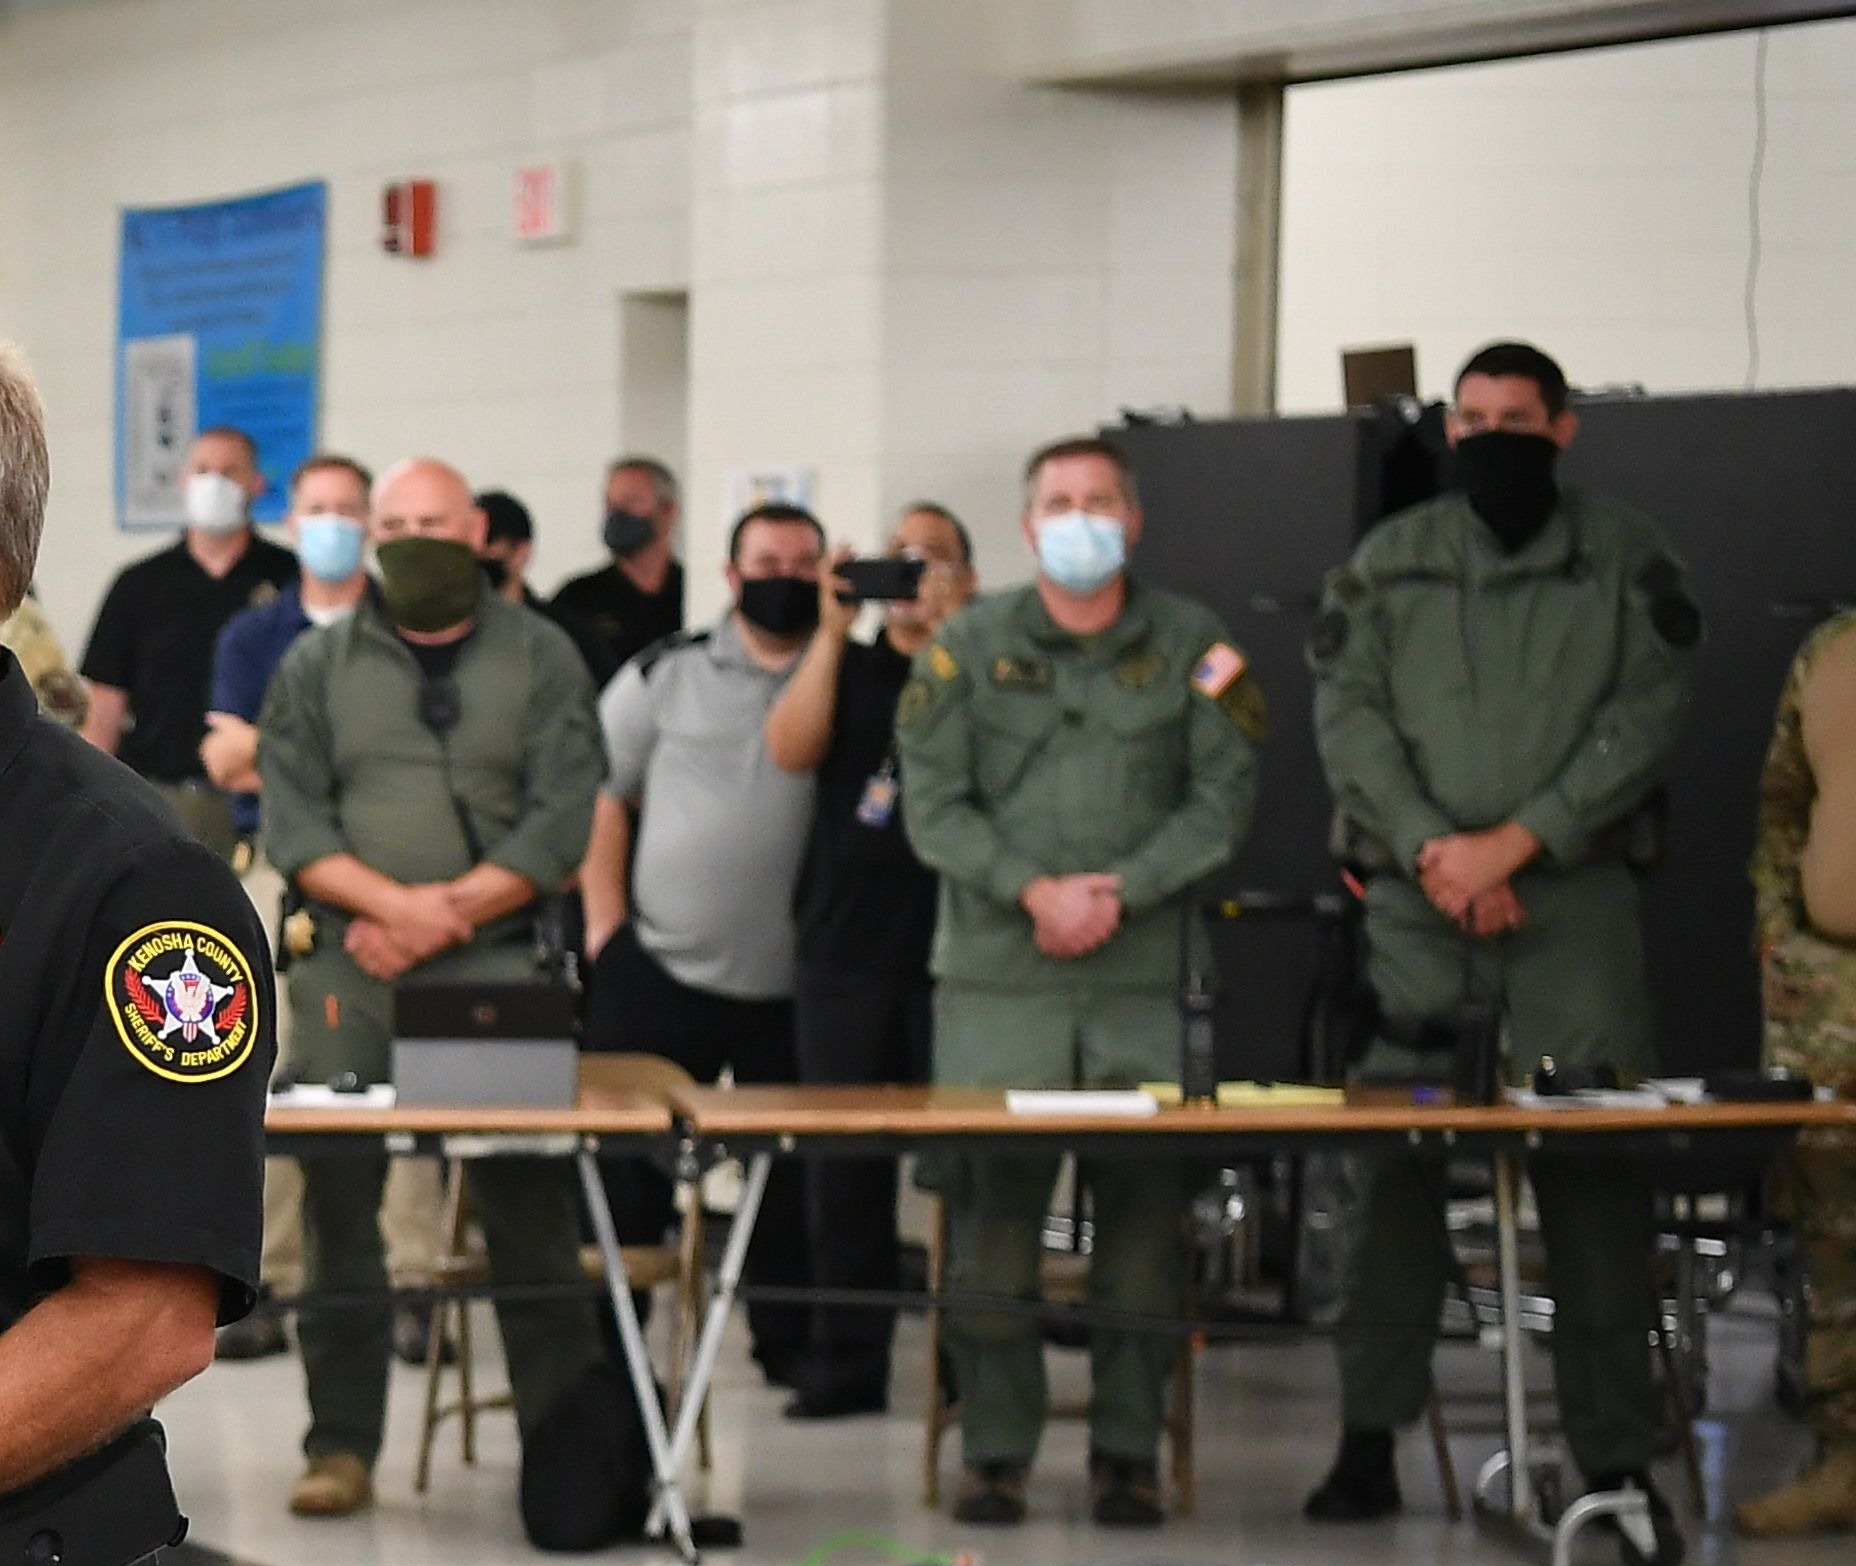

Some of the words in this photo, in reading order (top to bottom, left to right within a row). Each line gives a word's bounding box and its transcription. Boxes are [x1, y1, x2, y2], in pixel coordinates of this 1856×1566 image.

[127, 933, 194, 973] KENOSHA
[197, 937, 244, 982] COUNTY
[124, 1002, 175, 1061] SHERIFF'S
[181, 1018, 247, 1066] DEPARTMENT
